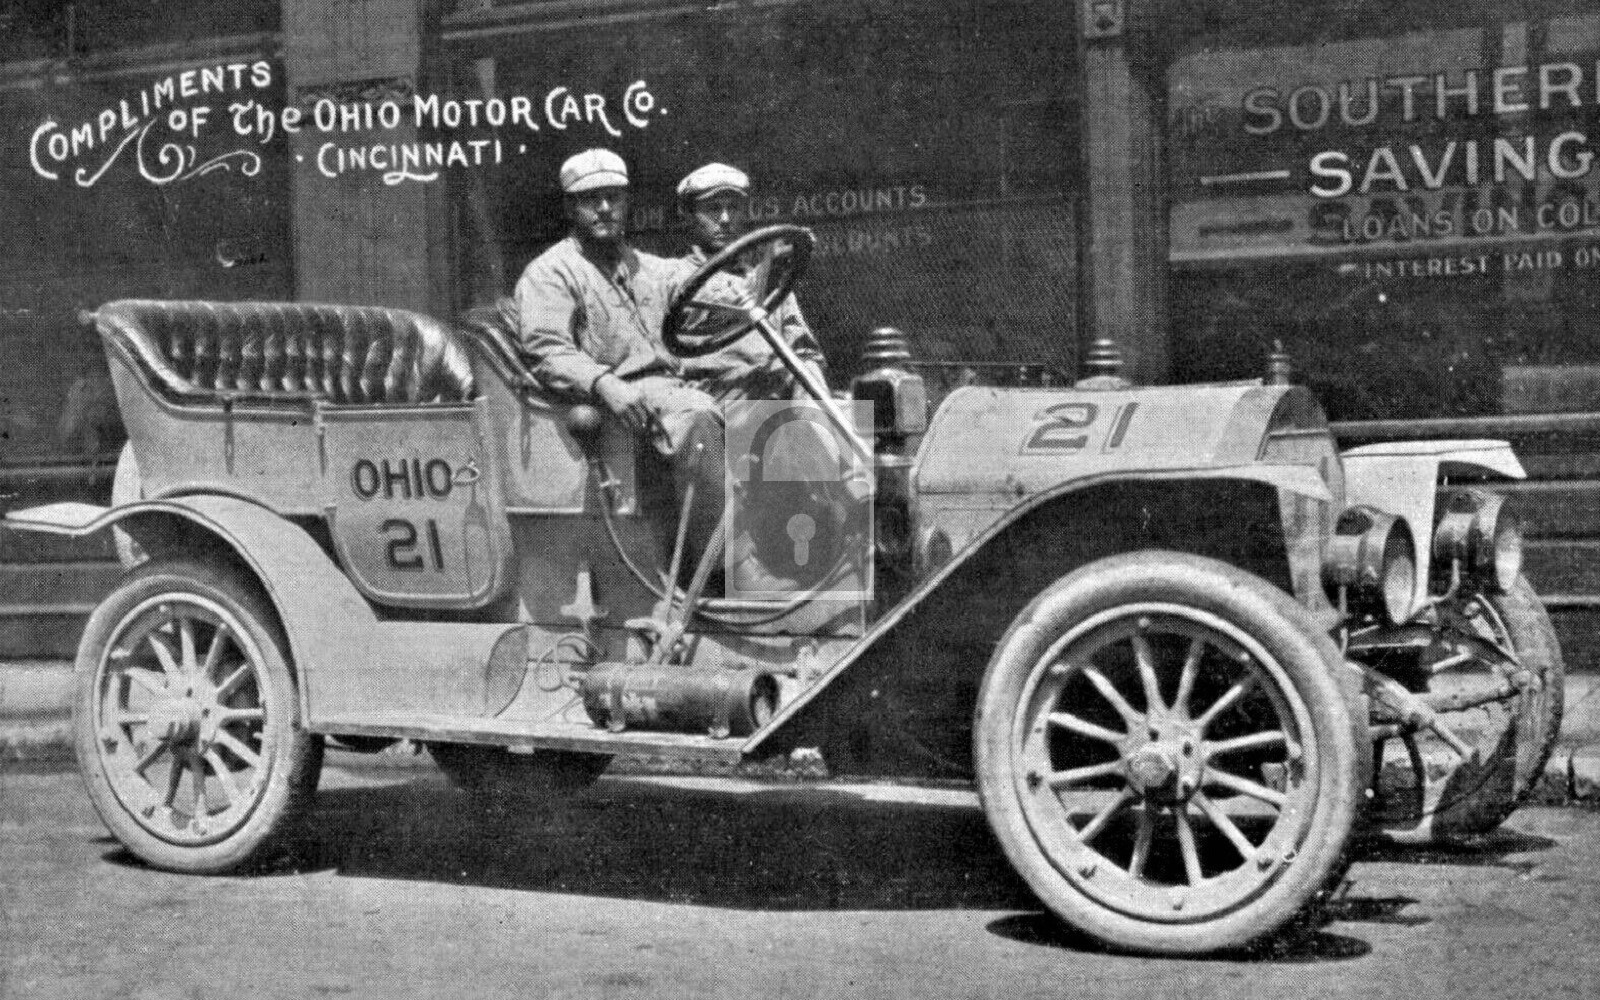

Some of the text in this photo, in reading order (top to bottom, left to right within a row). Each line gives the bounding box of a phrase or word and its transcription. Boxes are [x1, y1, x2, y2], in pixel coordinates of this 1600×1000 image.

[1243, 60, 1600, 135] SOUTHER
[1308, 131, 1596, 199] SAVING
[793, 184, 927, 216] ACCOUNTS
[1343, 210, 1453, 241] LOANS
[1472, 206, 1519, 234] ON
[1365, 254, 1488, 279] INTEREST
[1504, 251, 1563, 272] PAID
[1019, 402, 1140, 456] 21
[352, 458, 453, 500] OHIO
[378, 518, 445, 573] 21
